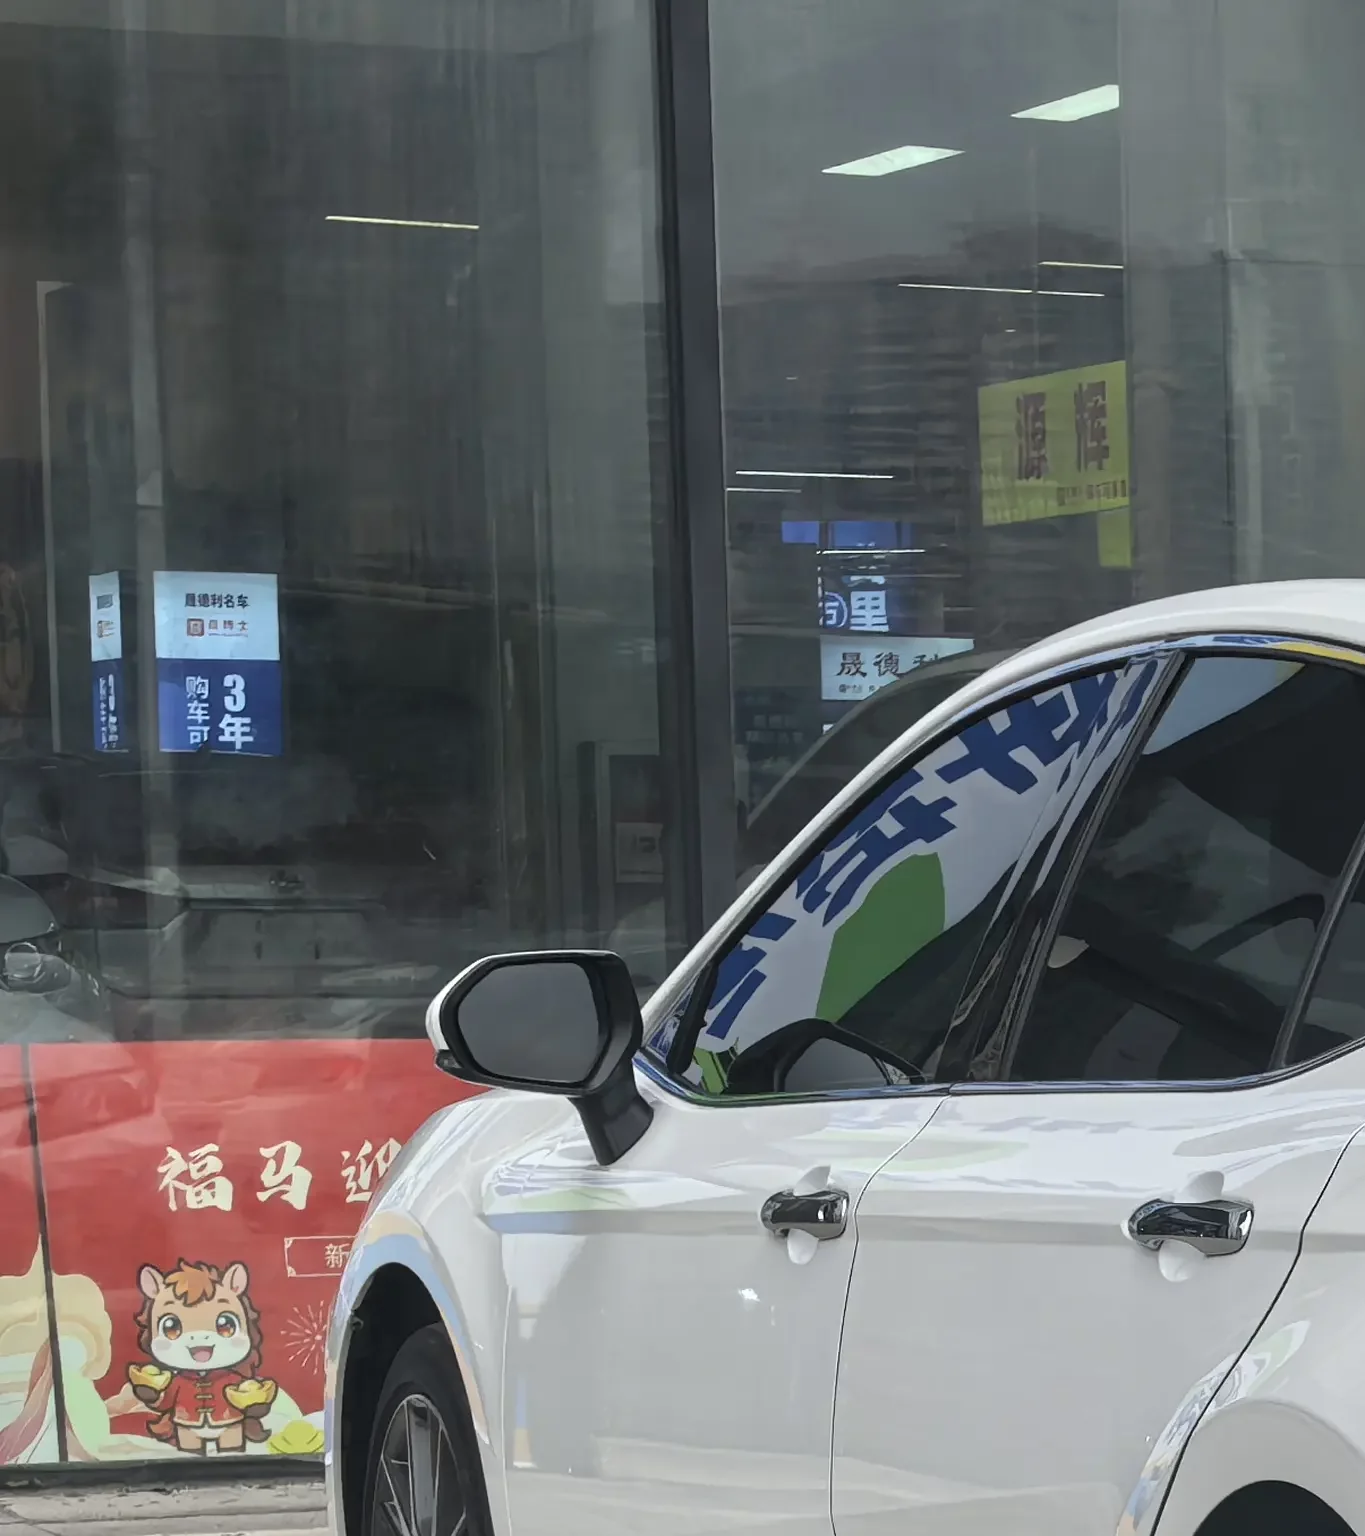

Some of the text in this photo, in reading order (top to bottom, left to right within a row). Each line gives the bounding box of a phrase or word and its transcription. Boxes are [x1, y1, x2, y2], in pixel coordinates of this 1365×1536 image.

[217, 672, 254, 750] 3年
[157, 1136, 403, 1212] 福马迎
